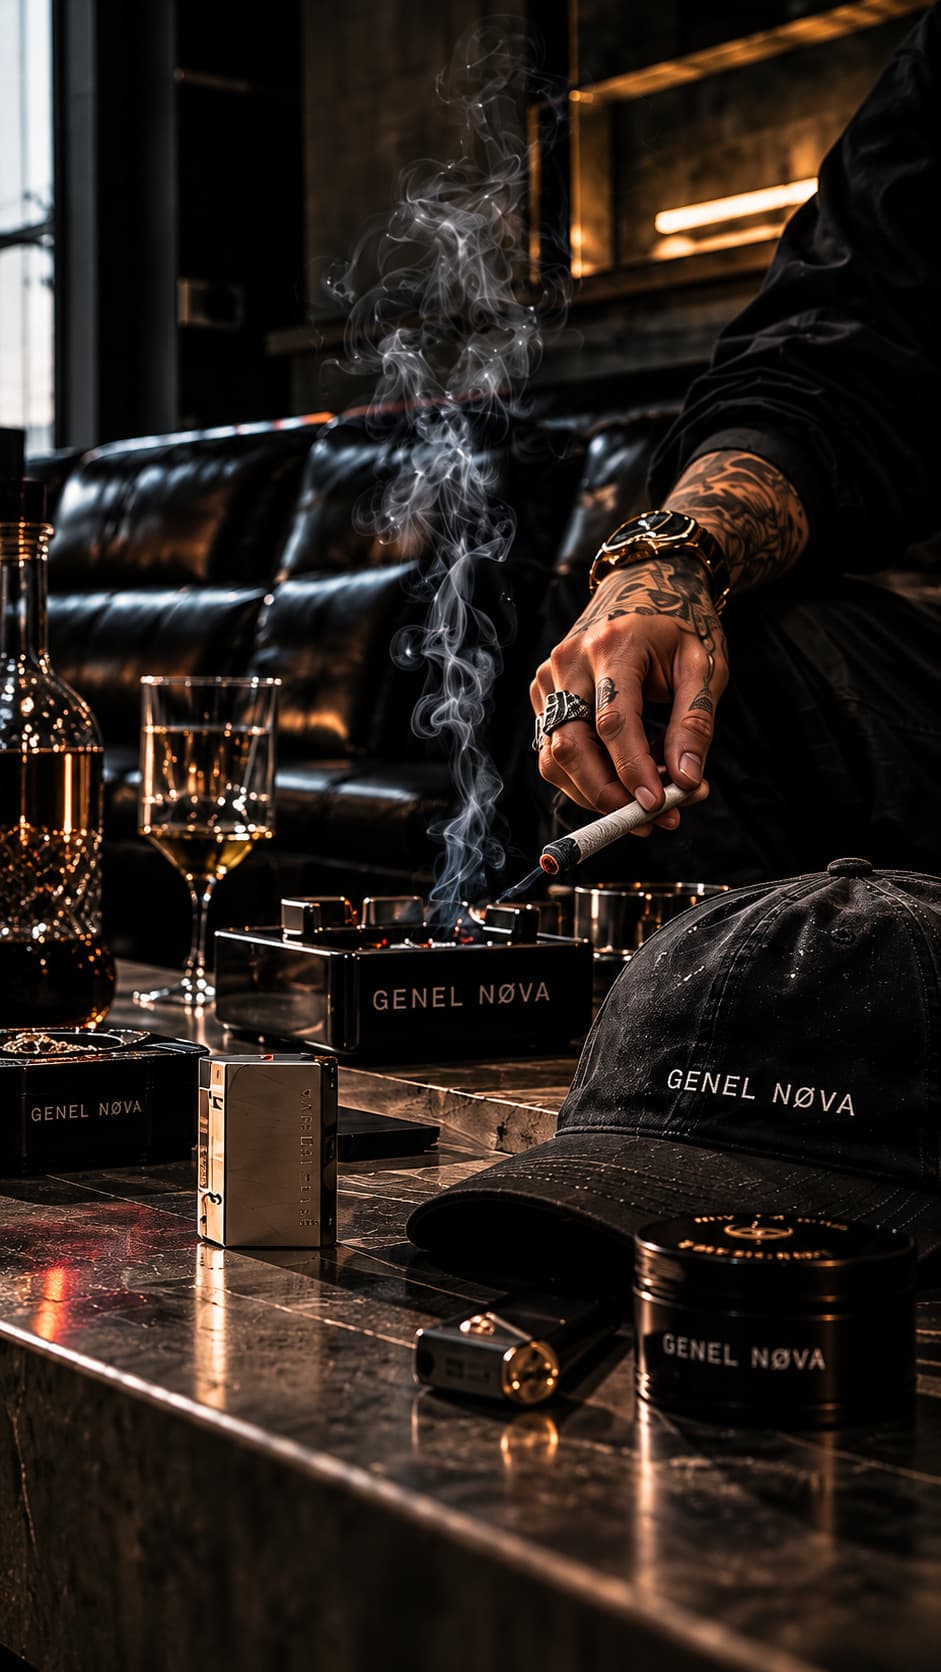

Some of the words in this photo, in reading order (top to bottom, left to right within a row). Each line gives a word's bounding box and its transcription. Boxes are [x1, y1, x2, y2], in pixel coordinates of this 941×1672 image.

[372, 986, 463, 1011] GENEL
[479, 981, 550, 1005] NØVA
[667, 1068, 756, 1100] GENEL
[772, 1082, 855, 1117] NØVA
[31, 1103, 89, 1122] GENEL
[98, 1100, 142, 1116] NØVA
[662, 1333, 739, 1367] GENEL
[751, 1347, 826, 1371] NØVA
